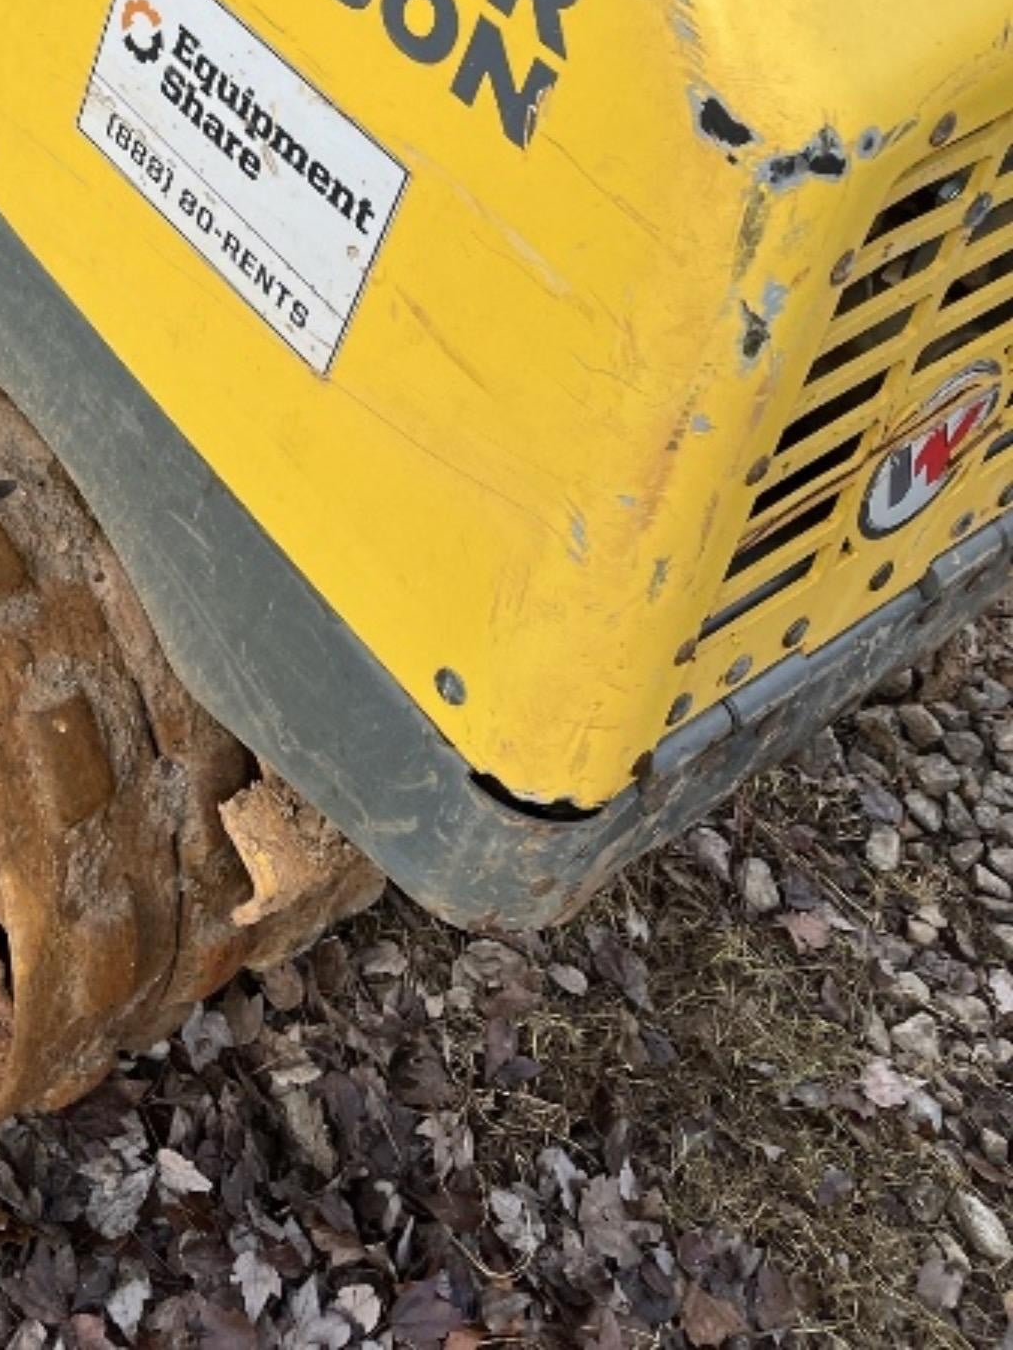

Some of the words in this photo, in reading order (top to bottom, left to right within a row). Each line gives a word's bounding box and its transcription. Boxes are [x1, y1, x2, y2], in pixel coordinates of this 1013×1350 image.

[105, 111, 175, 199] (888)
[177, 188, 310, 330] 80-RENTS
[160, 64, 263, 181] Share
[172, 23, 376, 235] Equipment
